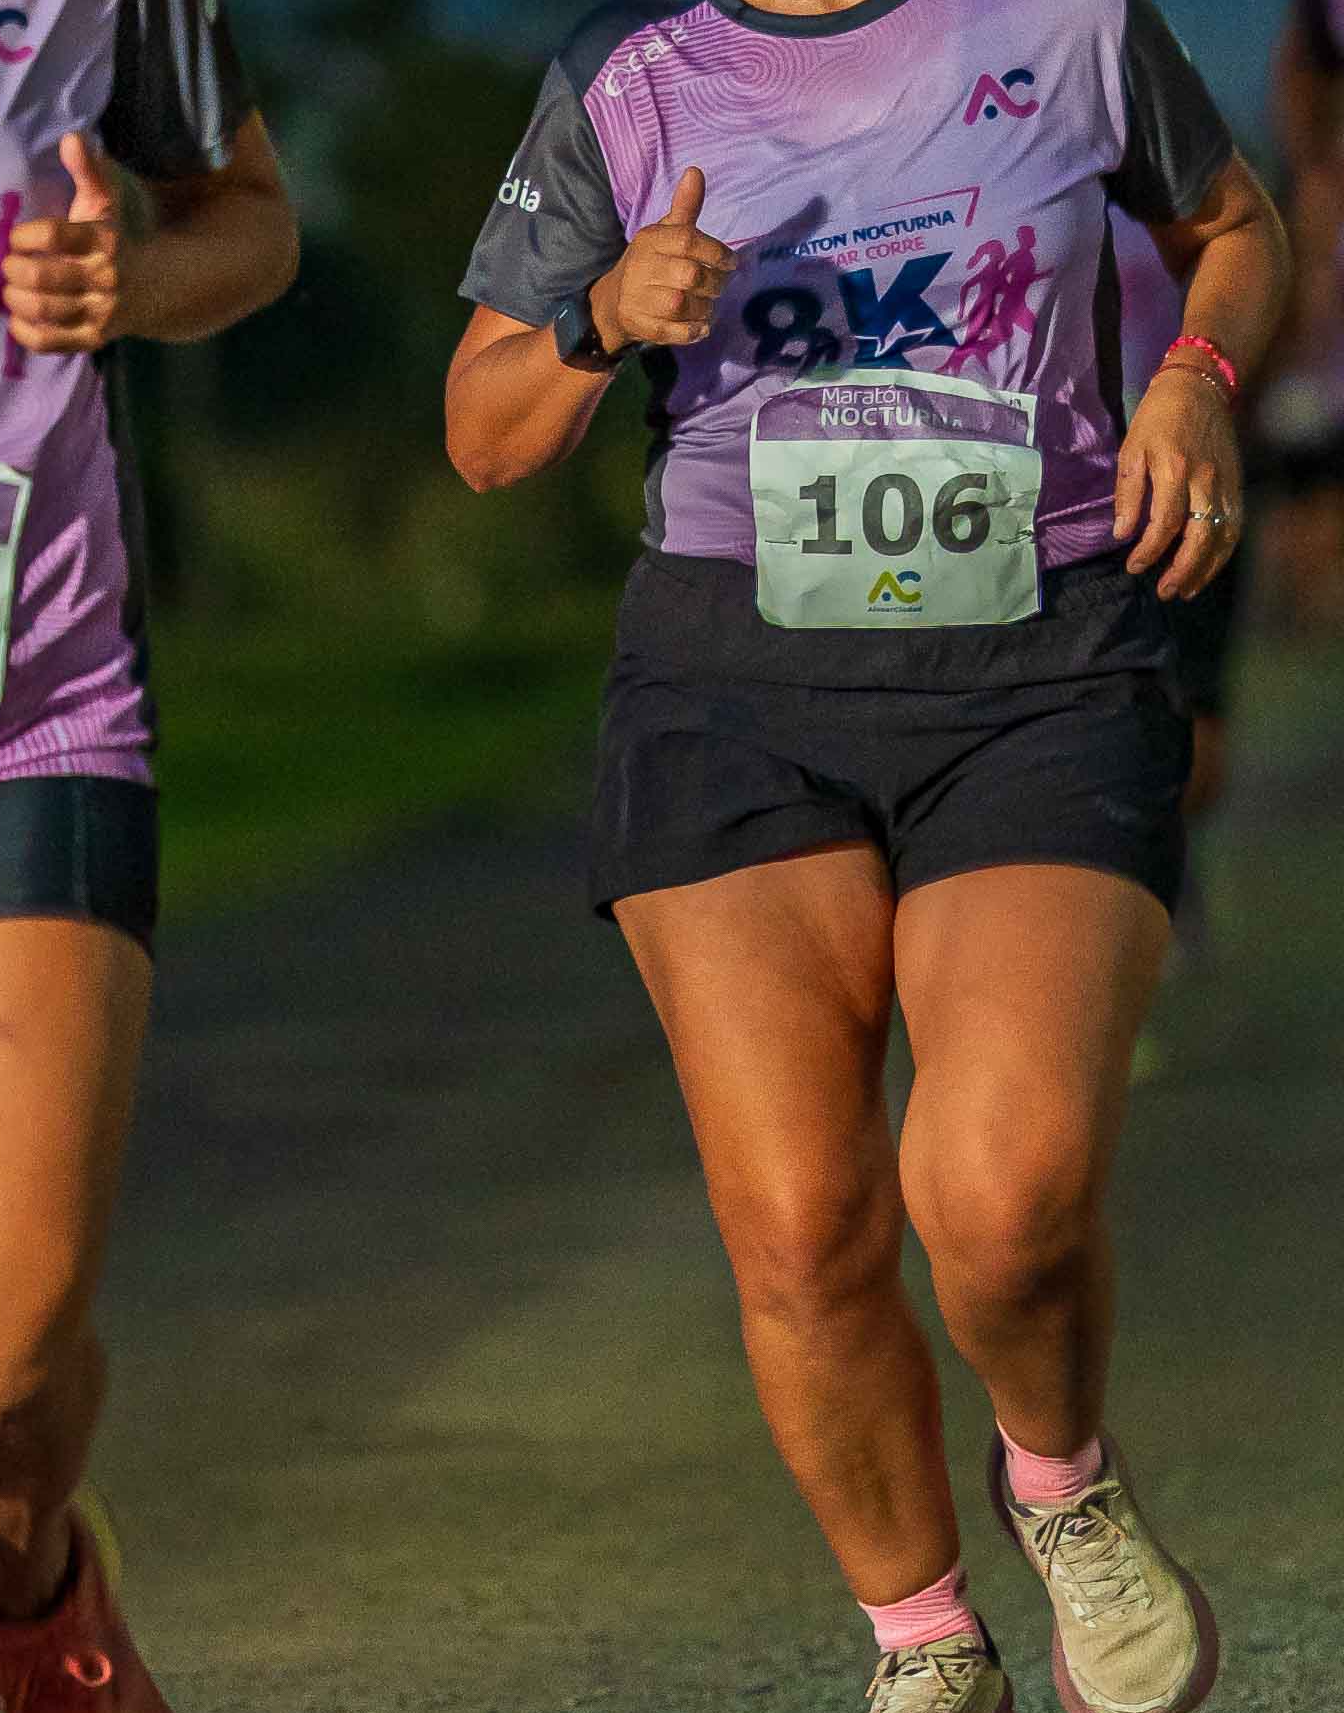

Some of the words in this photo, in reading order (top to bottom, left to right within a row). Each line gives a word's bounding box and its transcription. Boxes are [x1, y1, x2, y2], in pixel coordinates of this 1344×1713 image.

[853, 210, 956, 243] NOCTURNA
[865, 235, 927, 262] CORRE
[822, 385, 909, 405] Maratón
[800, 473, 991, 556] 106
